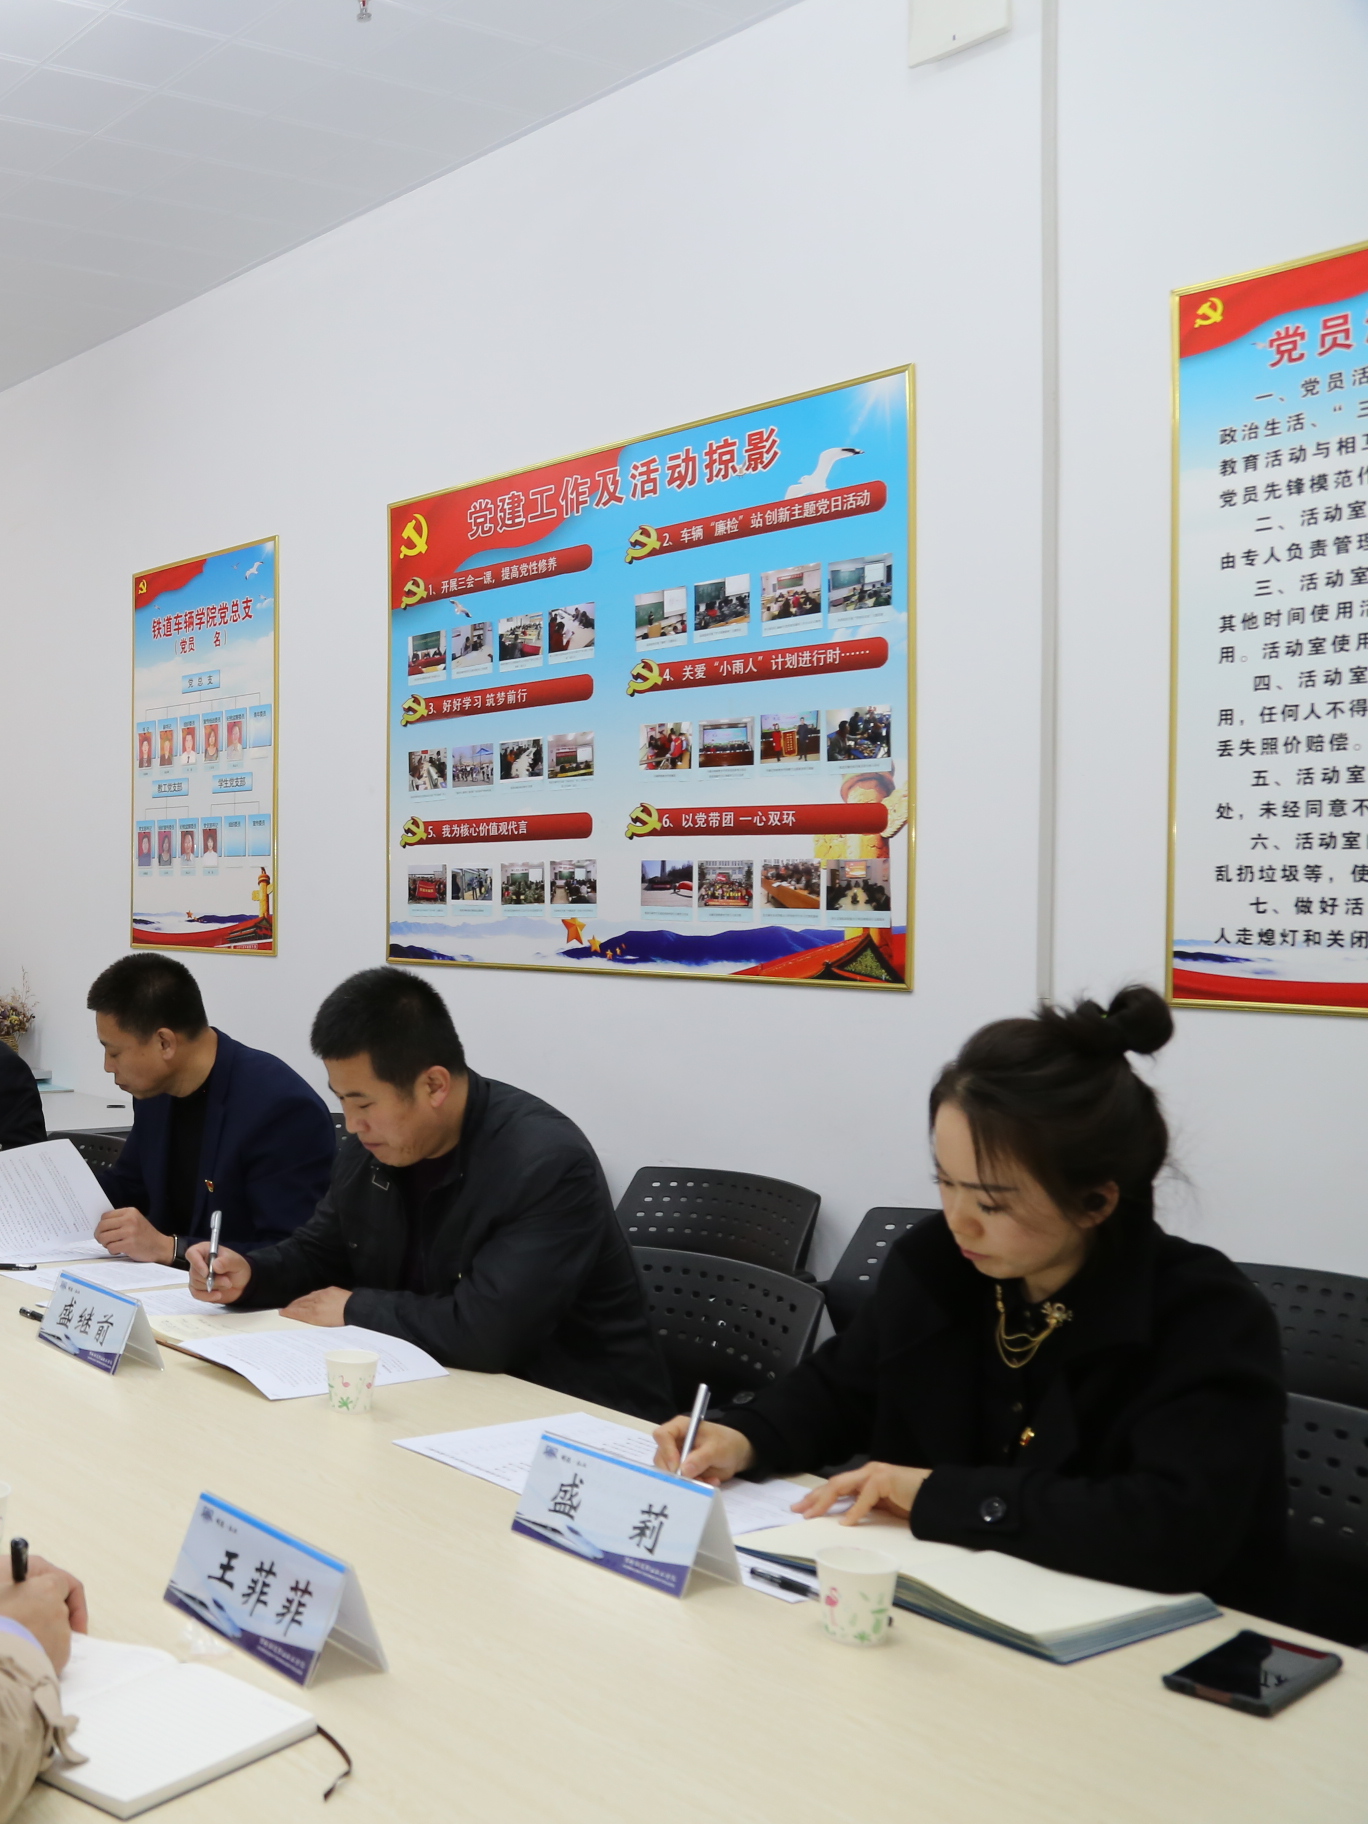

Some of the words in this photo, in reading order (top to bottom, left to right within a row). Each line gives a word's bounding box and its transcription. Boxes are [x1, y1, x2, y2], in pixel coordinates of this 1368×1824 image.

[1269, 310, 1368, 368] 党员
[468, 426, 781, 540] 党建工作及活动掠影
[1255, 501, 1367, 532] 二、活动室
[1254, 567, 1368, 597] 三、活动室
[152, 597, 253, 639] 铁道车辆学院党总支
[1253, 666, 1368, 691] 四、活动室
[486, 688, 528, 707] 筑梦前行
[1217, 732, 1361, 758] 丢失照价赔偿。
[1251, 765, 1367, 787] 五、活动室
[428, 820, 528, 838] 5、我为核心价值观代言
[662, 811, 734, 828] 6、以党带团
[739, 810, 796, 827] 一心双环
[1250, 831, 1368, 850] 六、活动室
[1215, 864, 1368, 883] 乱扔垃圾等，使
[1249, 897, 1364, 916] 七、做好活
[1214, 927, 1368, 949] 人走熄灯和关闭
[56, 1297, 114, 1347] 盛继前
[208, 1550, 313, 1637] 王菲菲
